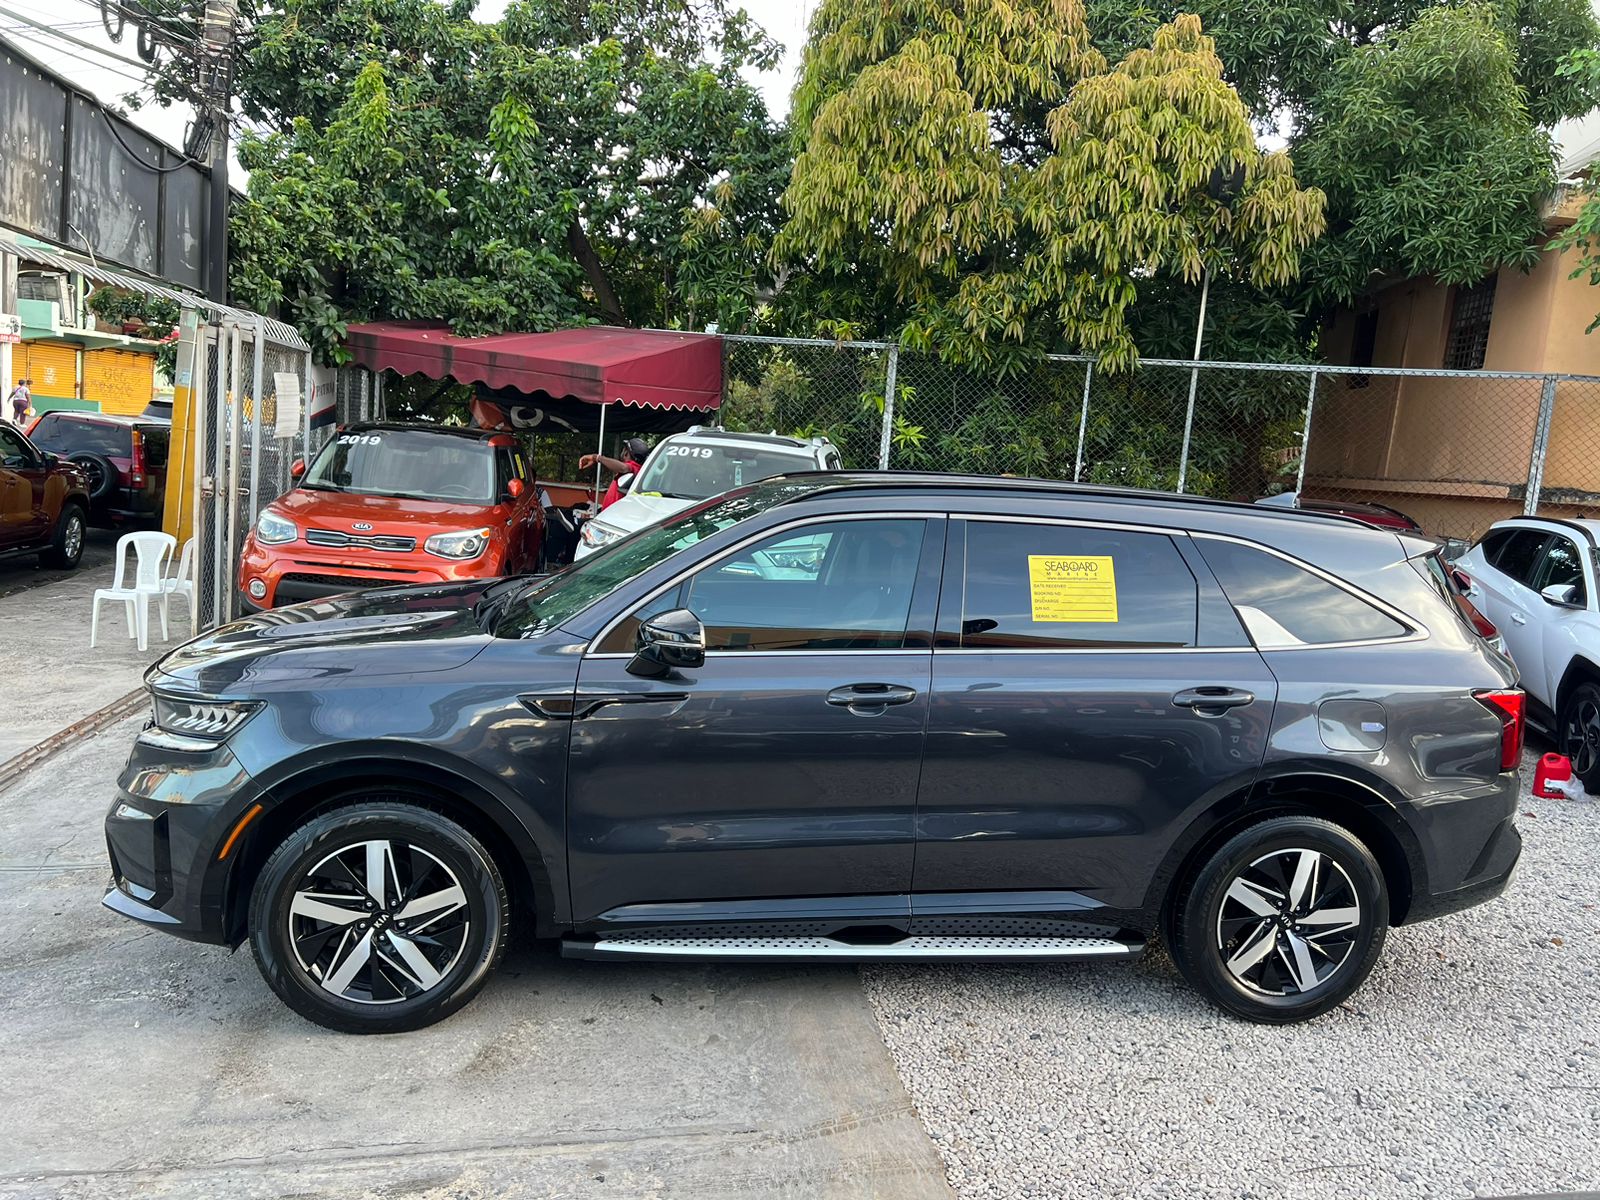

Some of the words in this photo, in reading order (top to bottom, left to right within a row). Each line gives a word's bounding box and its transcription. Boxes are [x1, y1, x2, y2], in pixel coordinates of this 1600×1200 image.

[337, 435, 381, 446] 2019
[666, 446, 713, 459] 2019
[1044, 560, 1098, 572] SEABOARD
[373, 914, 389, 928] KIA
[1281, 914, 1292, 928] KIA
